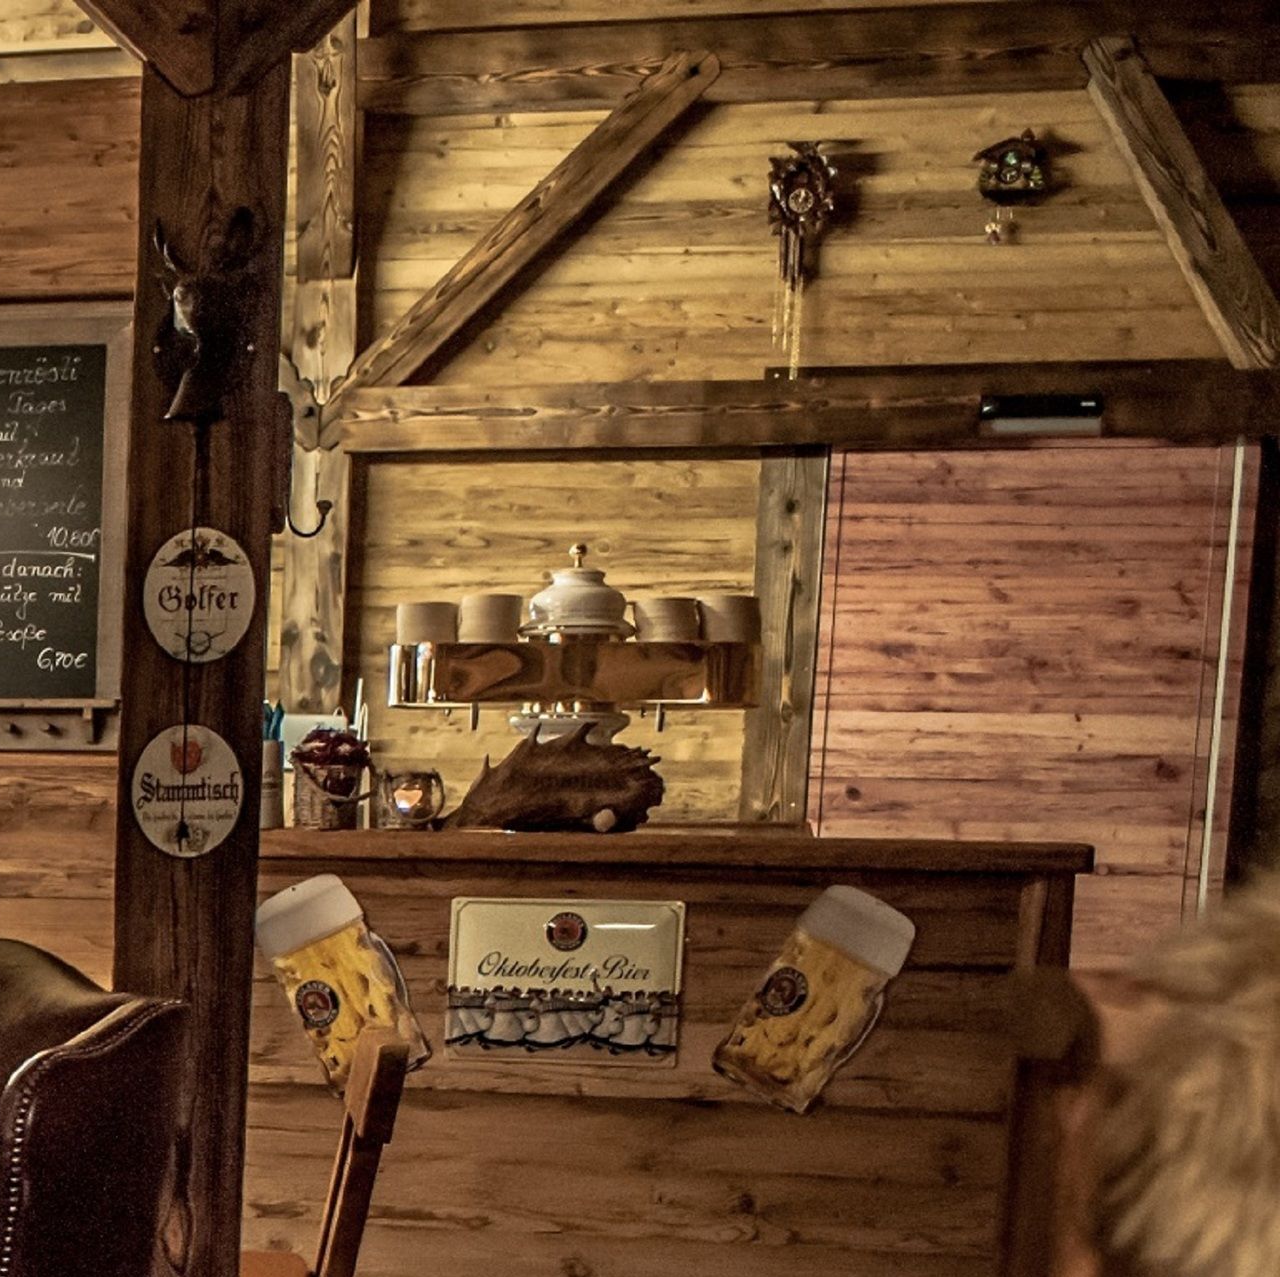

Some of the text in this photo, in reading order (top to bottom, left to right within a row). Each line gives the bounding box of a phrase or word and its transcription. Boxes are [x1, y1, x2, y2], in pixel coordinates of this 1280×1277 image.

[1, 557, 83, 579] danach:
[48, 586, 82, 603] mit
[157, 584, 240, 616] Golfer
[136, 771, 240, 809] Stammtisch
[477, 950, 652, 983] Oktoberfest Bier
